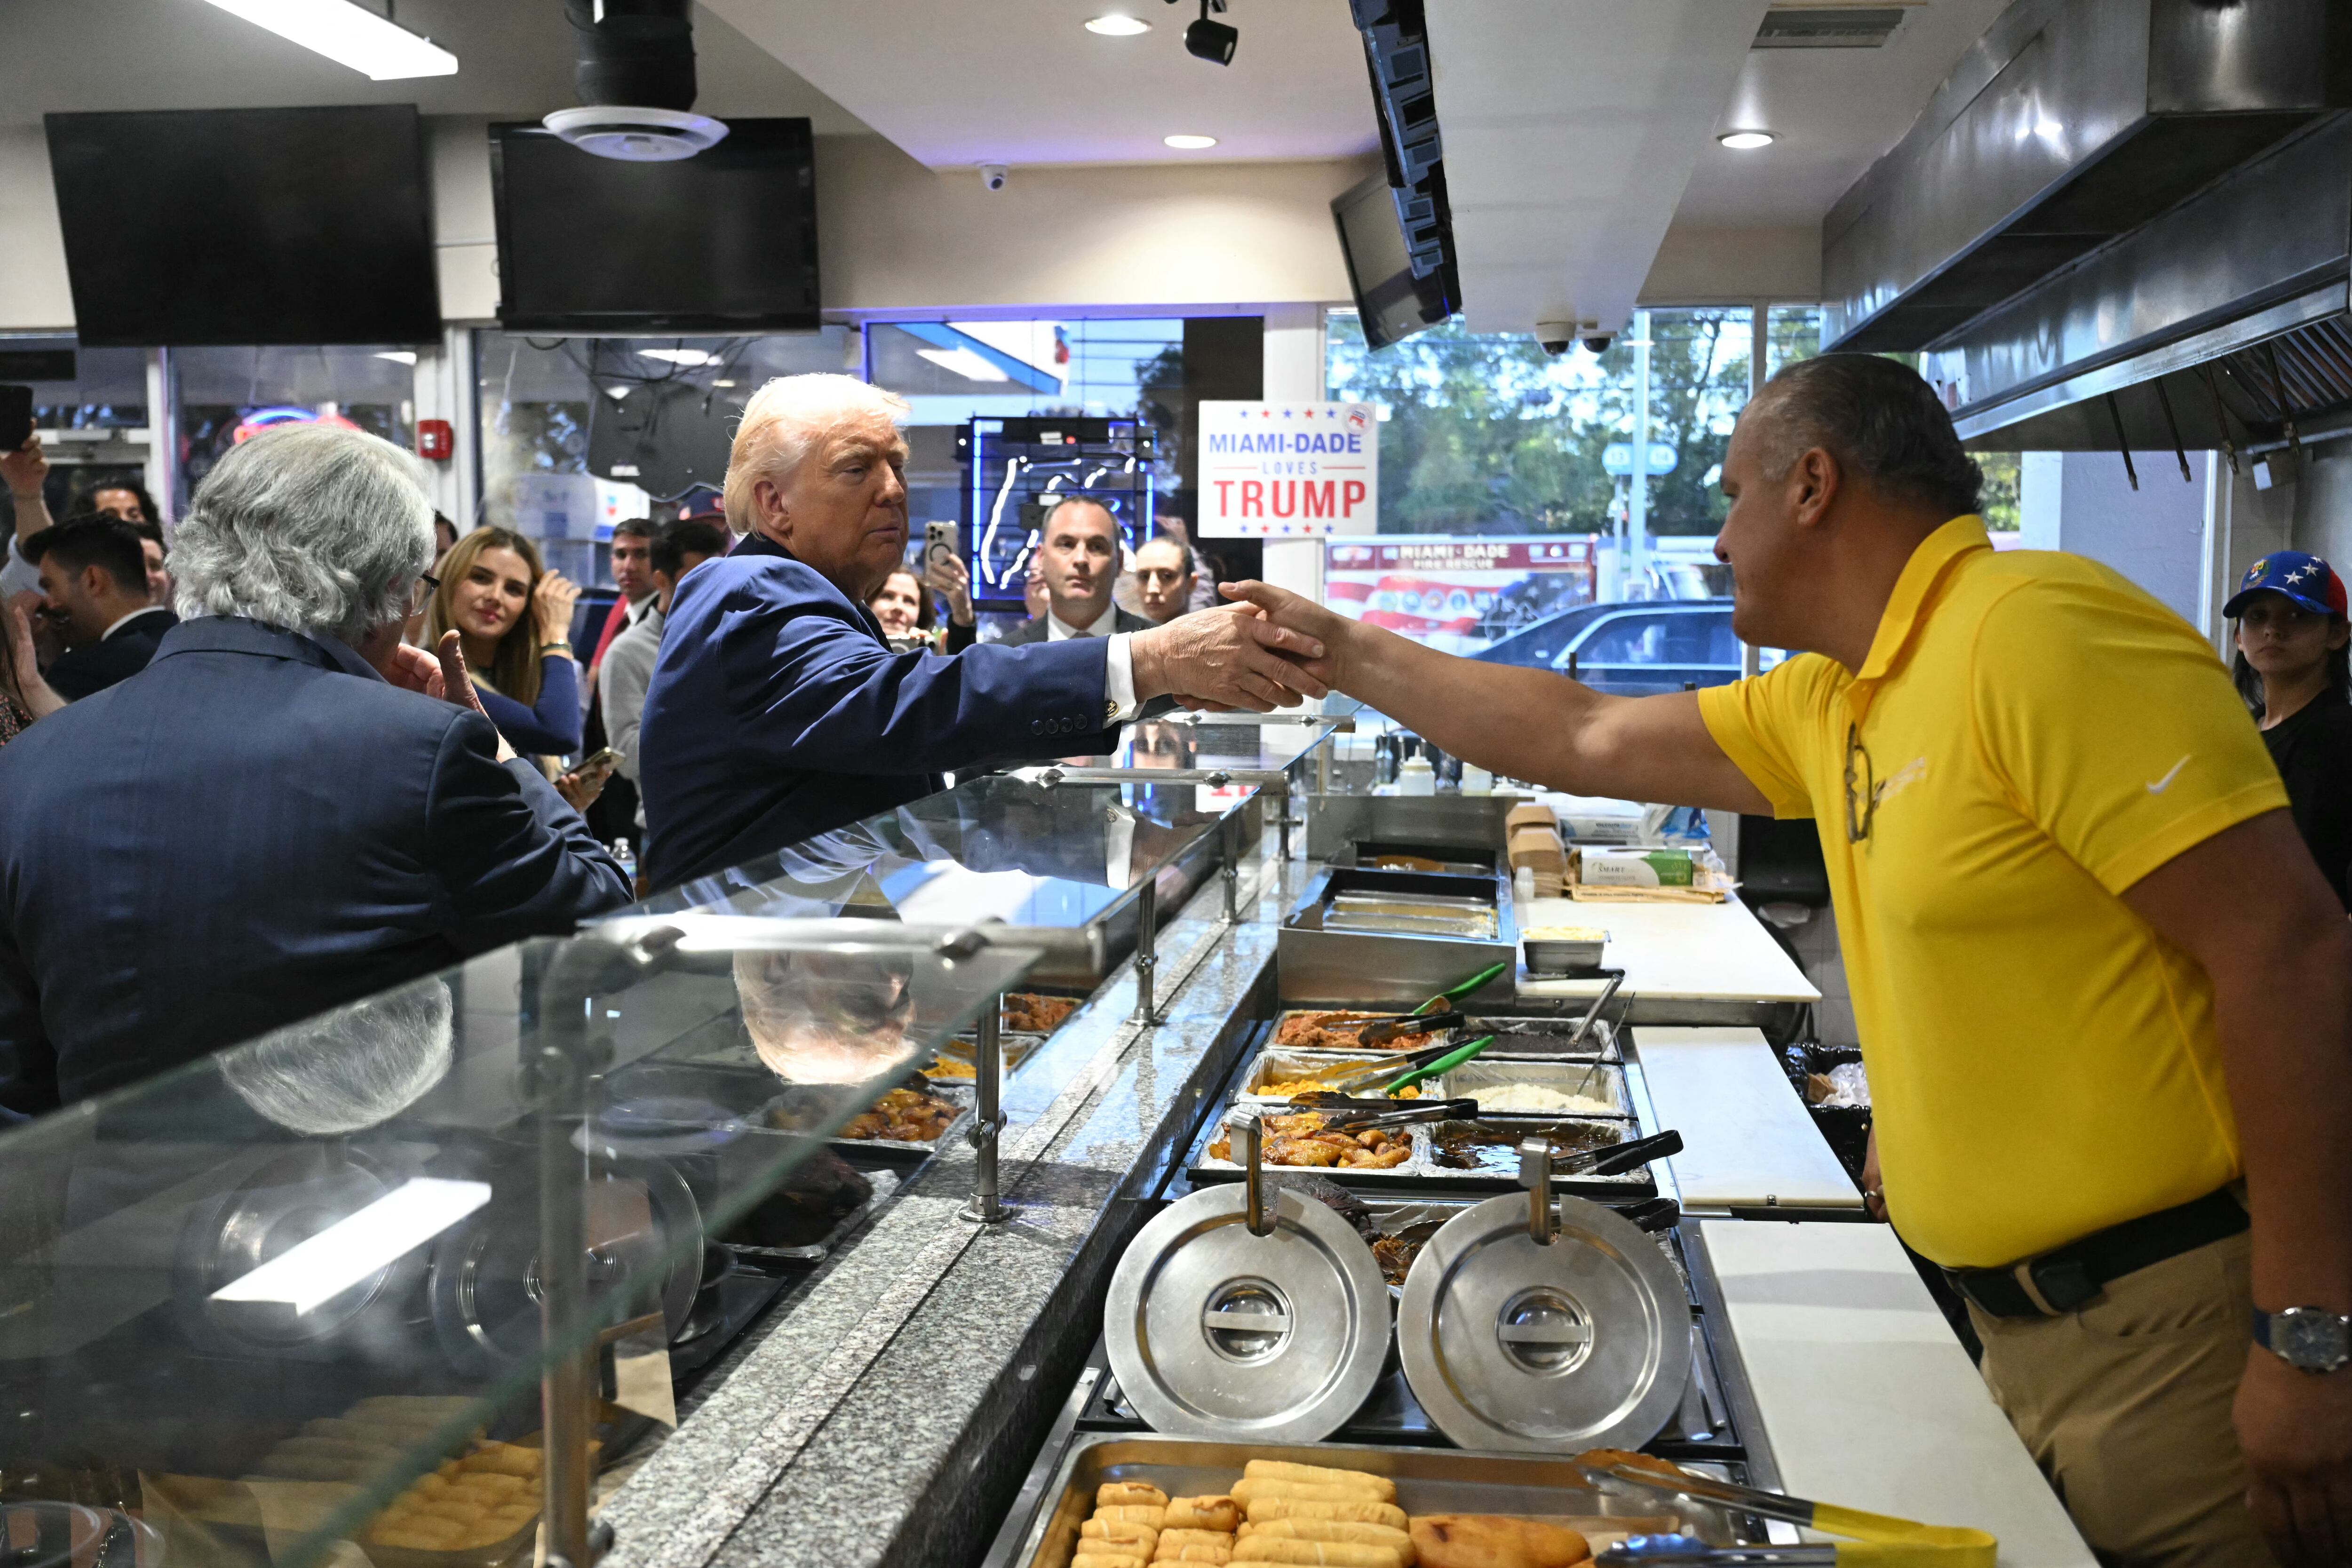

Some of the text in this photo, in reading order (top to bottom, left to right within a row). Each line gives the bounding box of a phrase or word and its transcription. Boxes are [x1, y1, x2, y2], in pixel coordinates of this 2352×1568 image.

[1209, 433, 1362, 454] MIAMI-DADE
[1262, 461, 1319, 475] LOVES
[1213, 480, 1366, 518] TRUMP
[1399, 543, 1510, 559] MIAMI DADE
